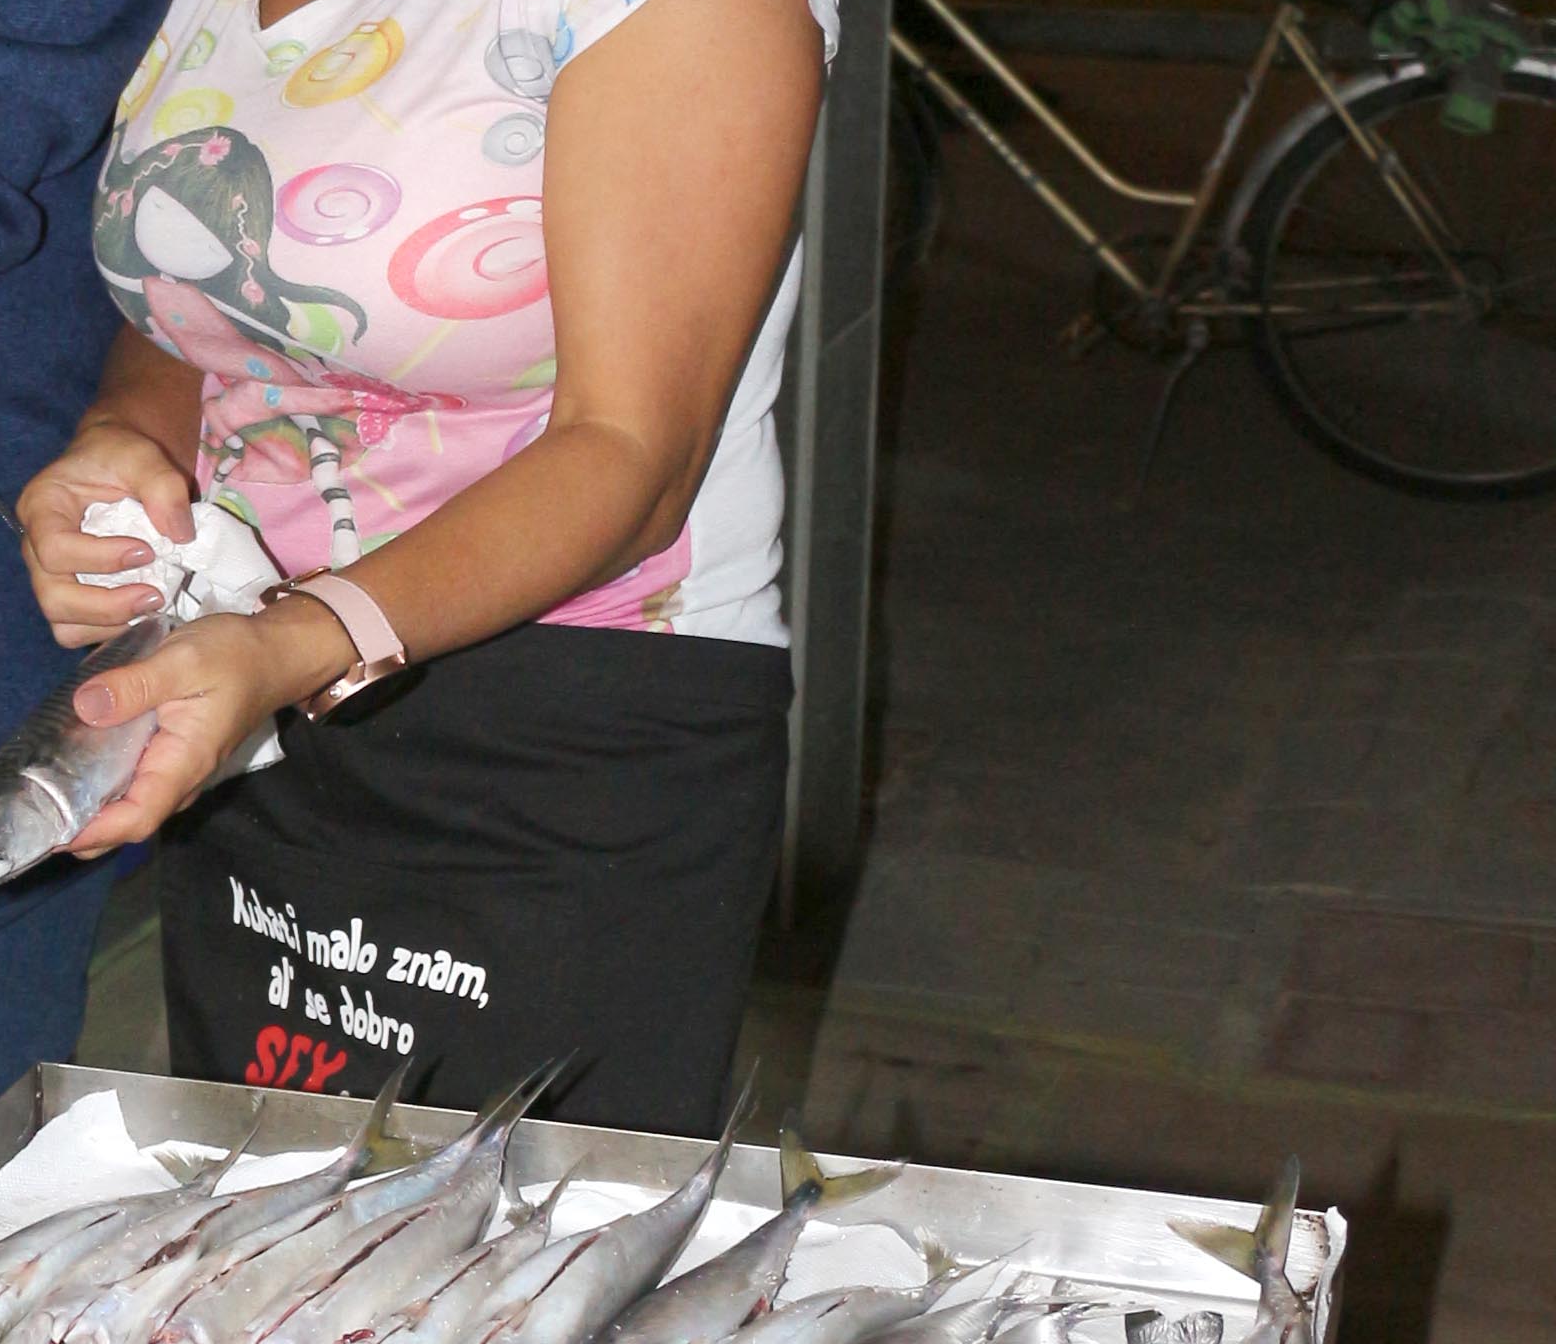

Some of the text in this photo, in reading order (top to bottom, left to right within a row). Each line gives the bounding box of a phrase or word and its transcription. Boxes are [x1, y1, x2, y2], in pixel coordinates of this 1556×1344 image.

[229, 876, 489, 1009] Kuhati malo znam,
[305, 987, 332, 1026] se
[339, 985, 415, 1055] dobro
